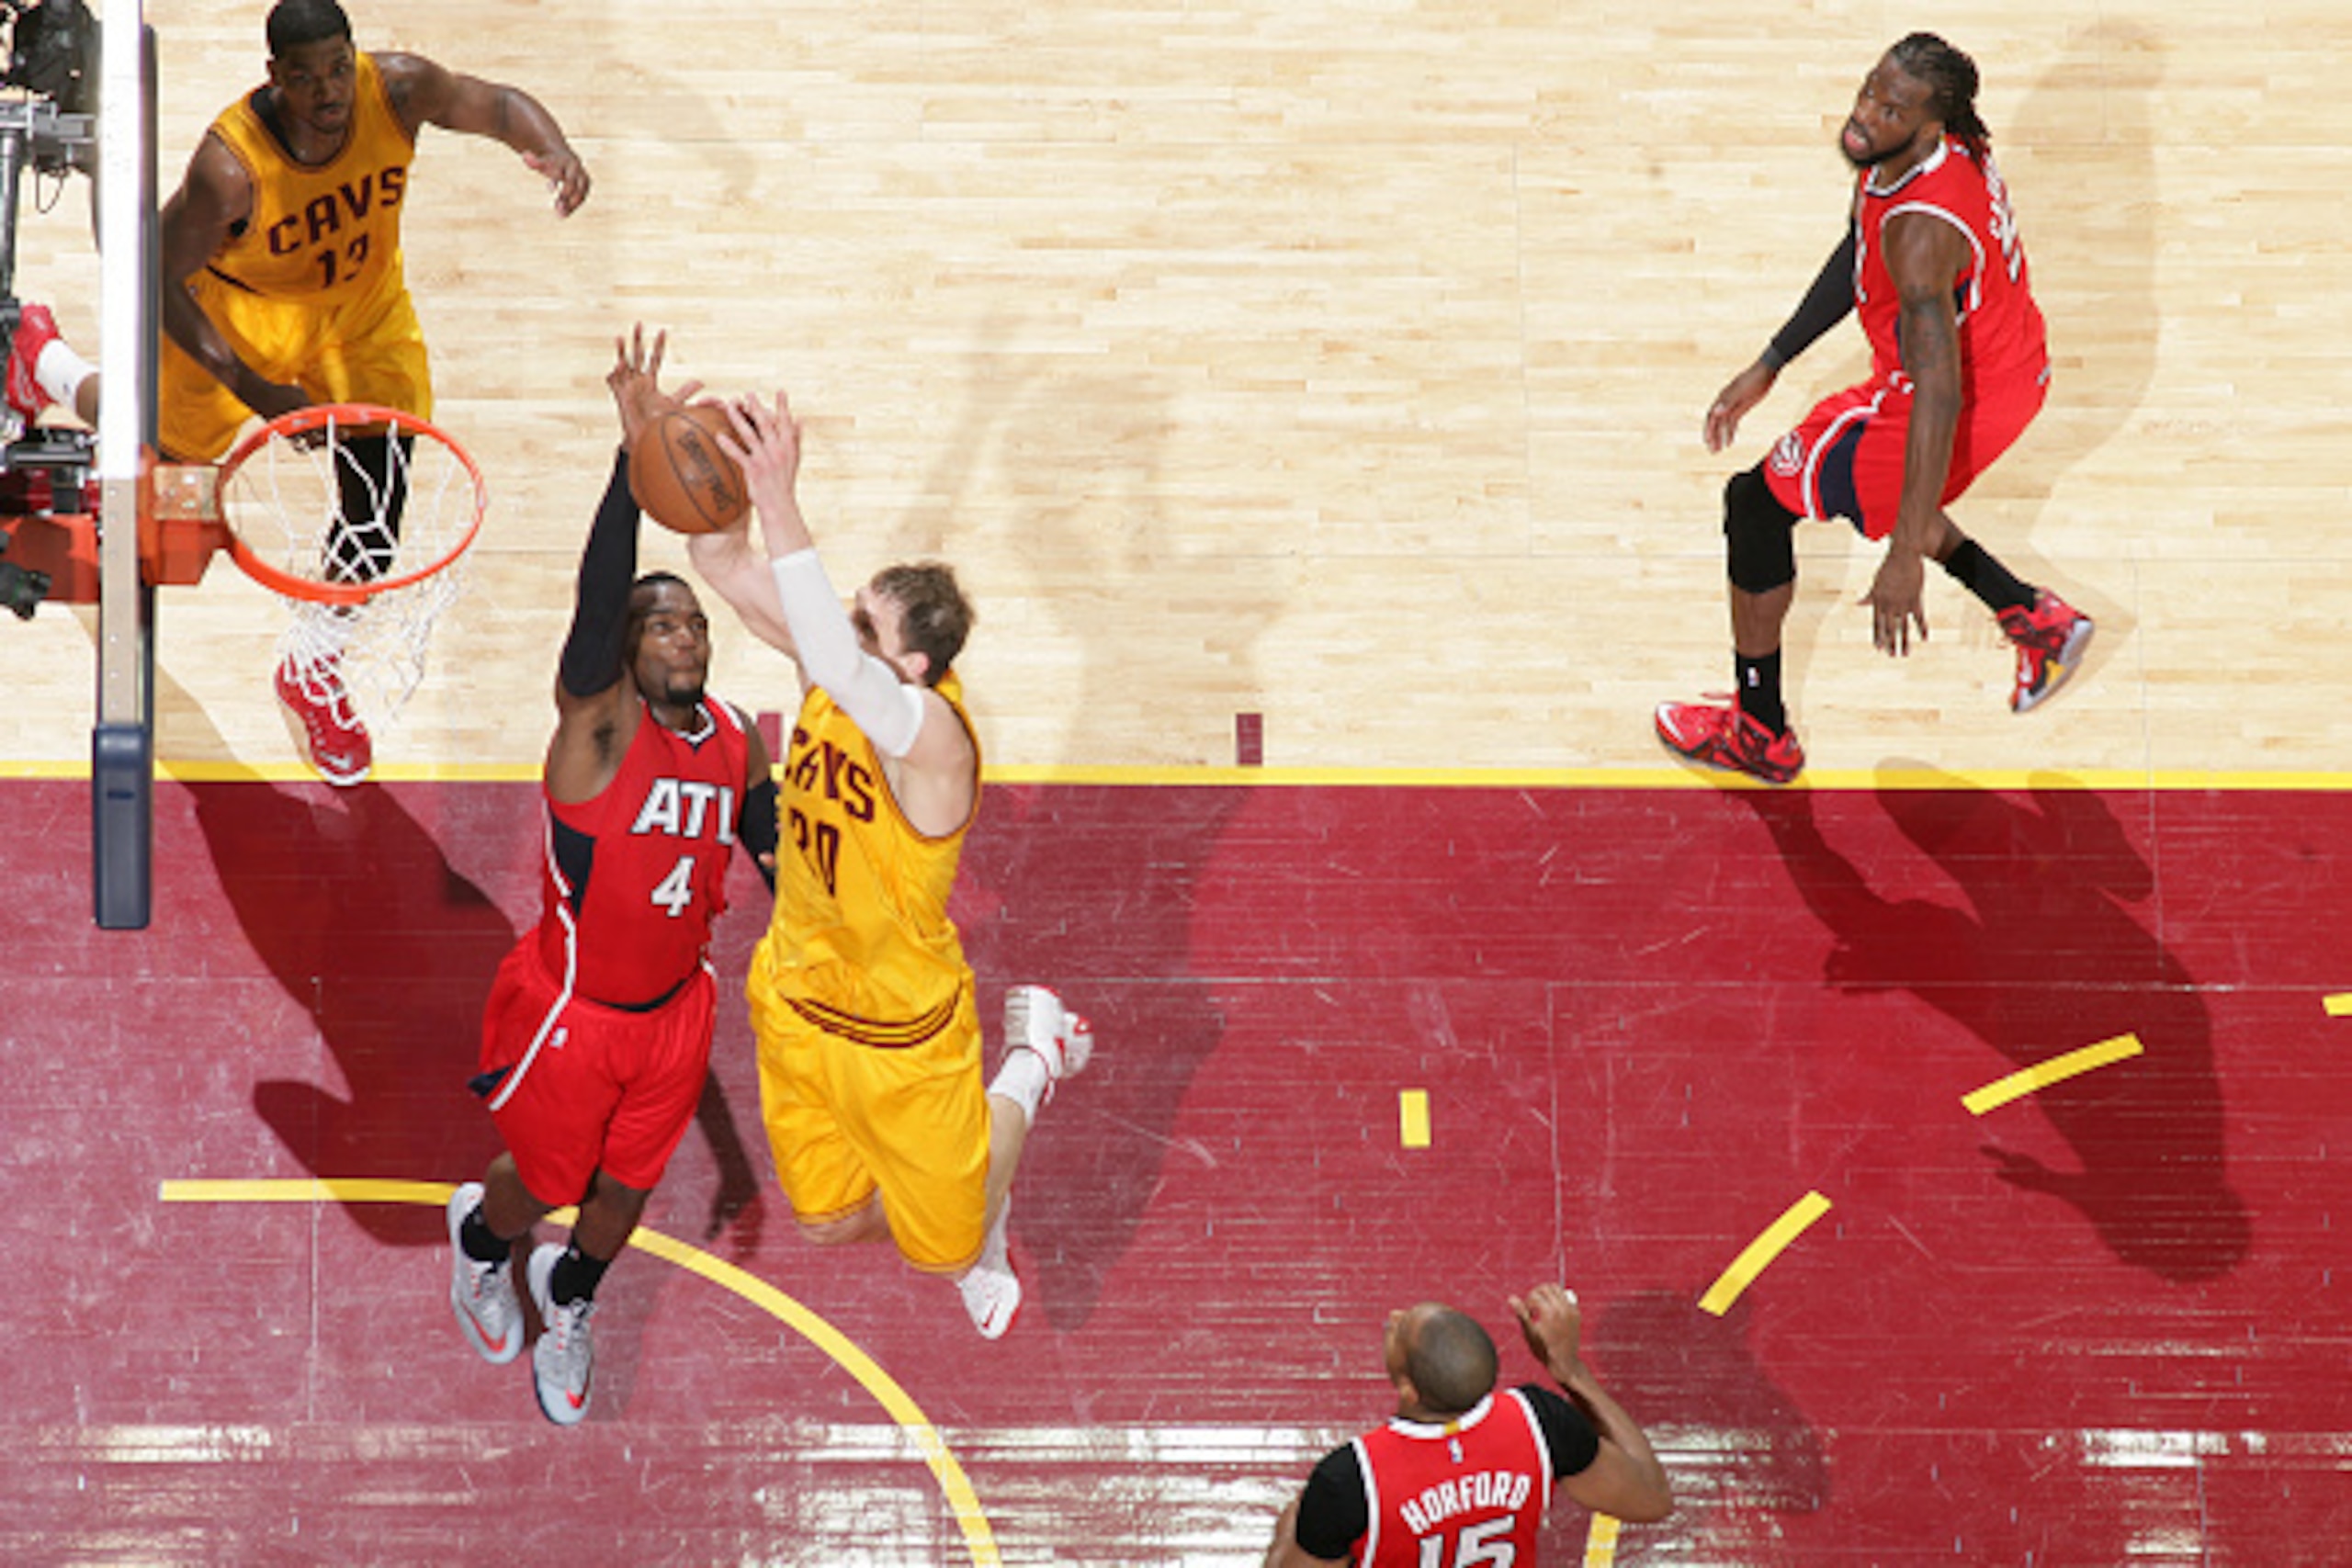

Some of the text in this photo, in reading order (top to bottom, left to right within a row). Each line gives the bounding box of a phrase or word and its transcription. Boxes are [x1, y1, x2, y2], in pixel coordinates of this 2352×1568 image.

[269, 166, 403, 255] CAVS
[650, 855, 695, 918] 4
[1399, 1471, 1532, 1534] HORFORD
